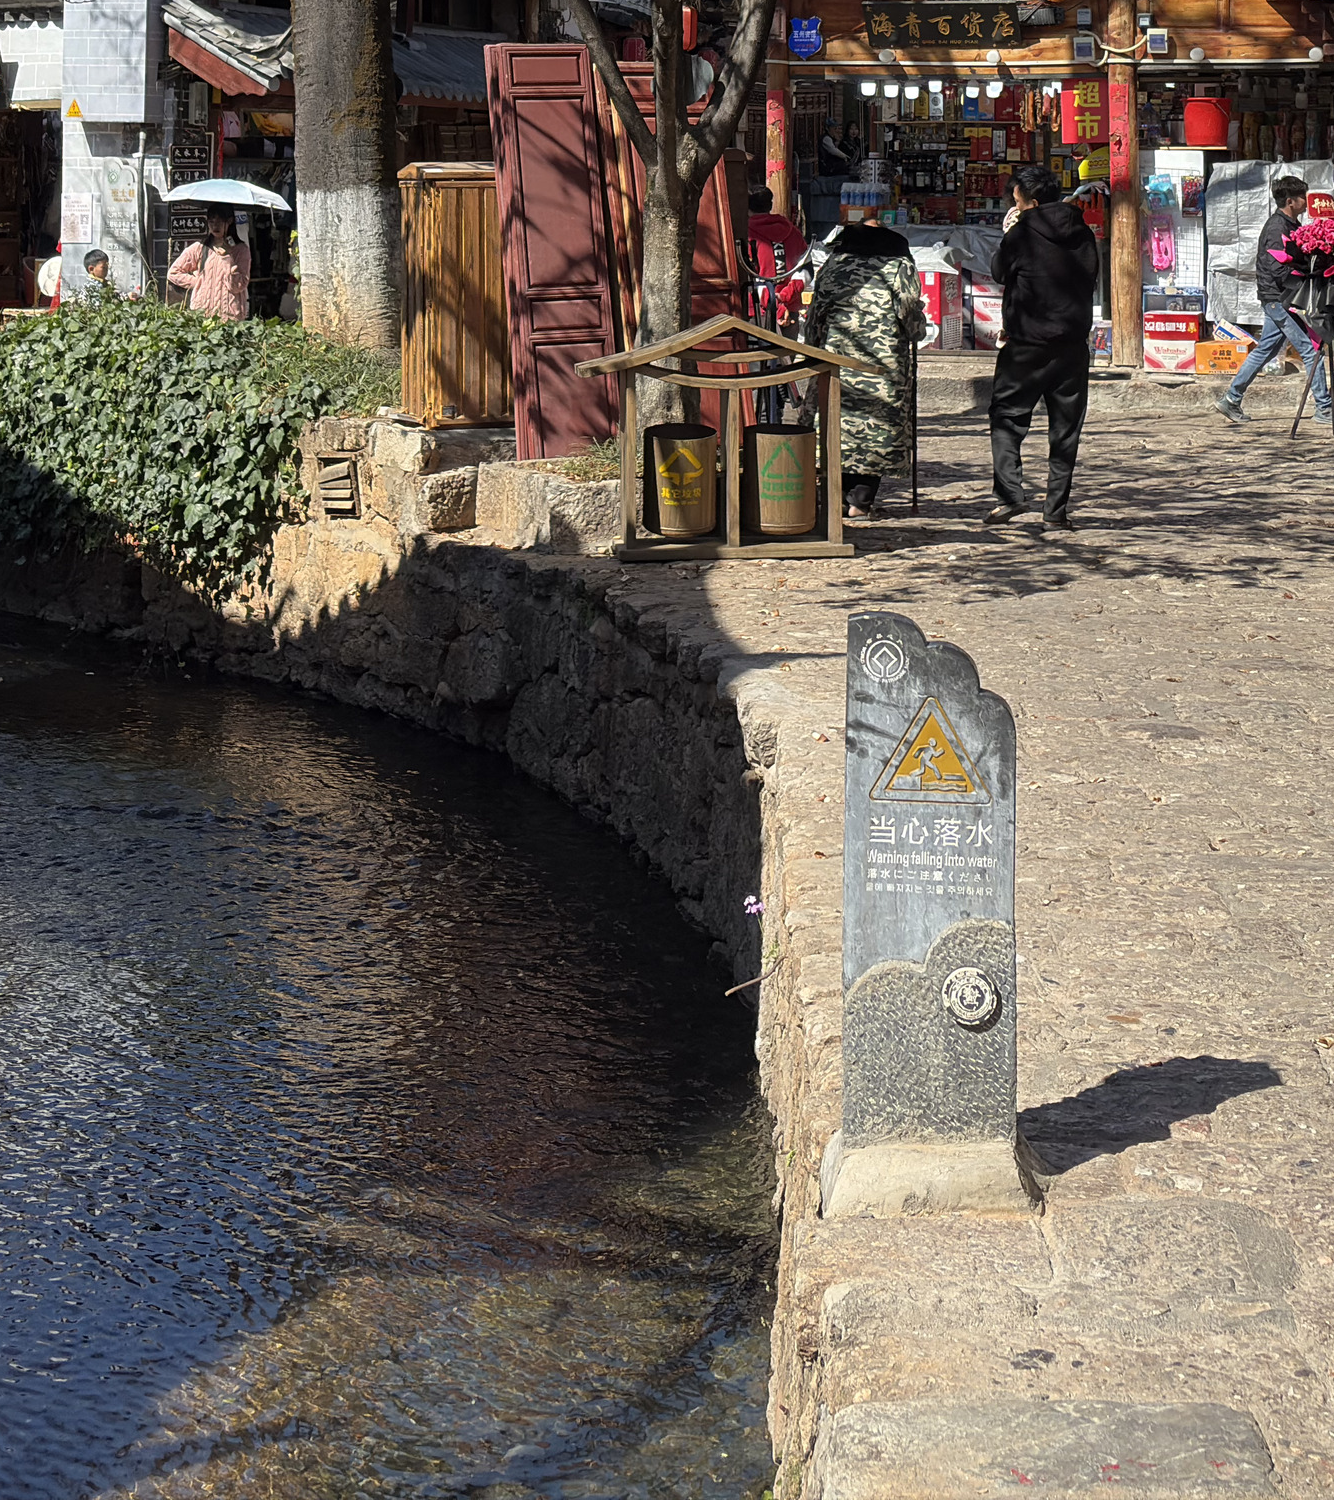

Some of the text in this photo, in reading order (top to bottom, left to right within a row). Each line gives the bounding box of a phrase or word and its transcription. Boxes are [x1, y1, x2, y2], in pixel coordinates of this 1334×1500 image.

[869, 10, 1015, 38] 海青百货店
[1072, 80, 1101, 139] 超市
[868, 815, 994, 848] 当心落水
[867, 849, 909, 868] Warning
[911, 850, 943, 869] falling
[967, 855, 998, 868] water
[867, 868, 997, 883] 落水にご注意ください
[948, 885, 994, 897] 주의하세요
